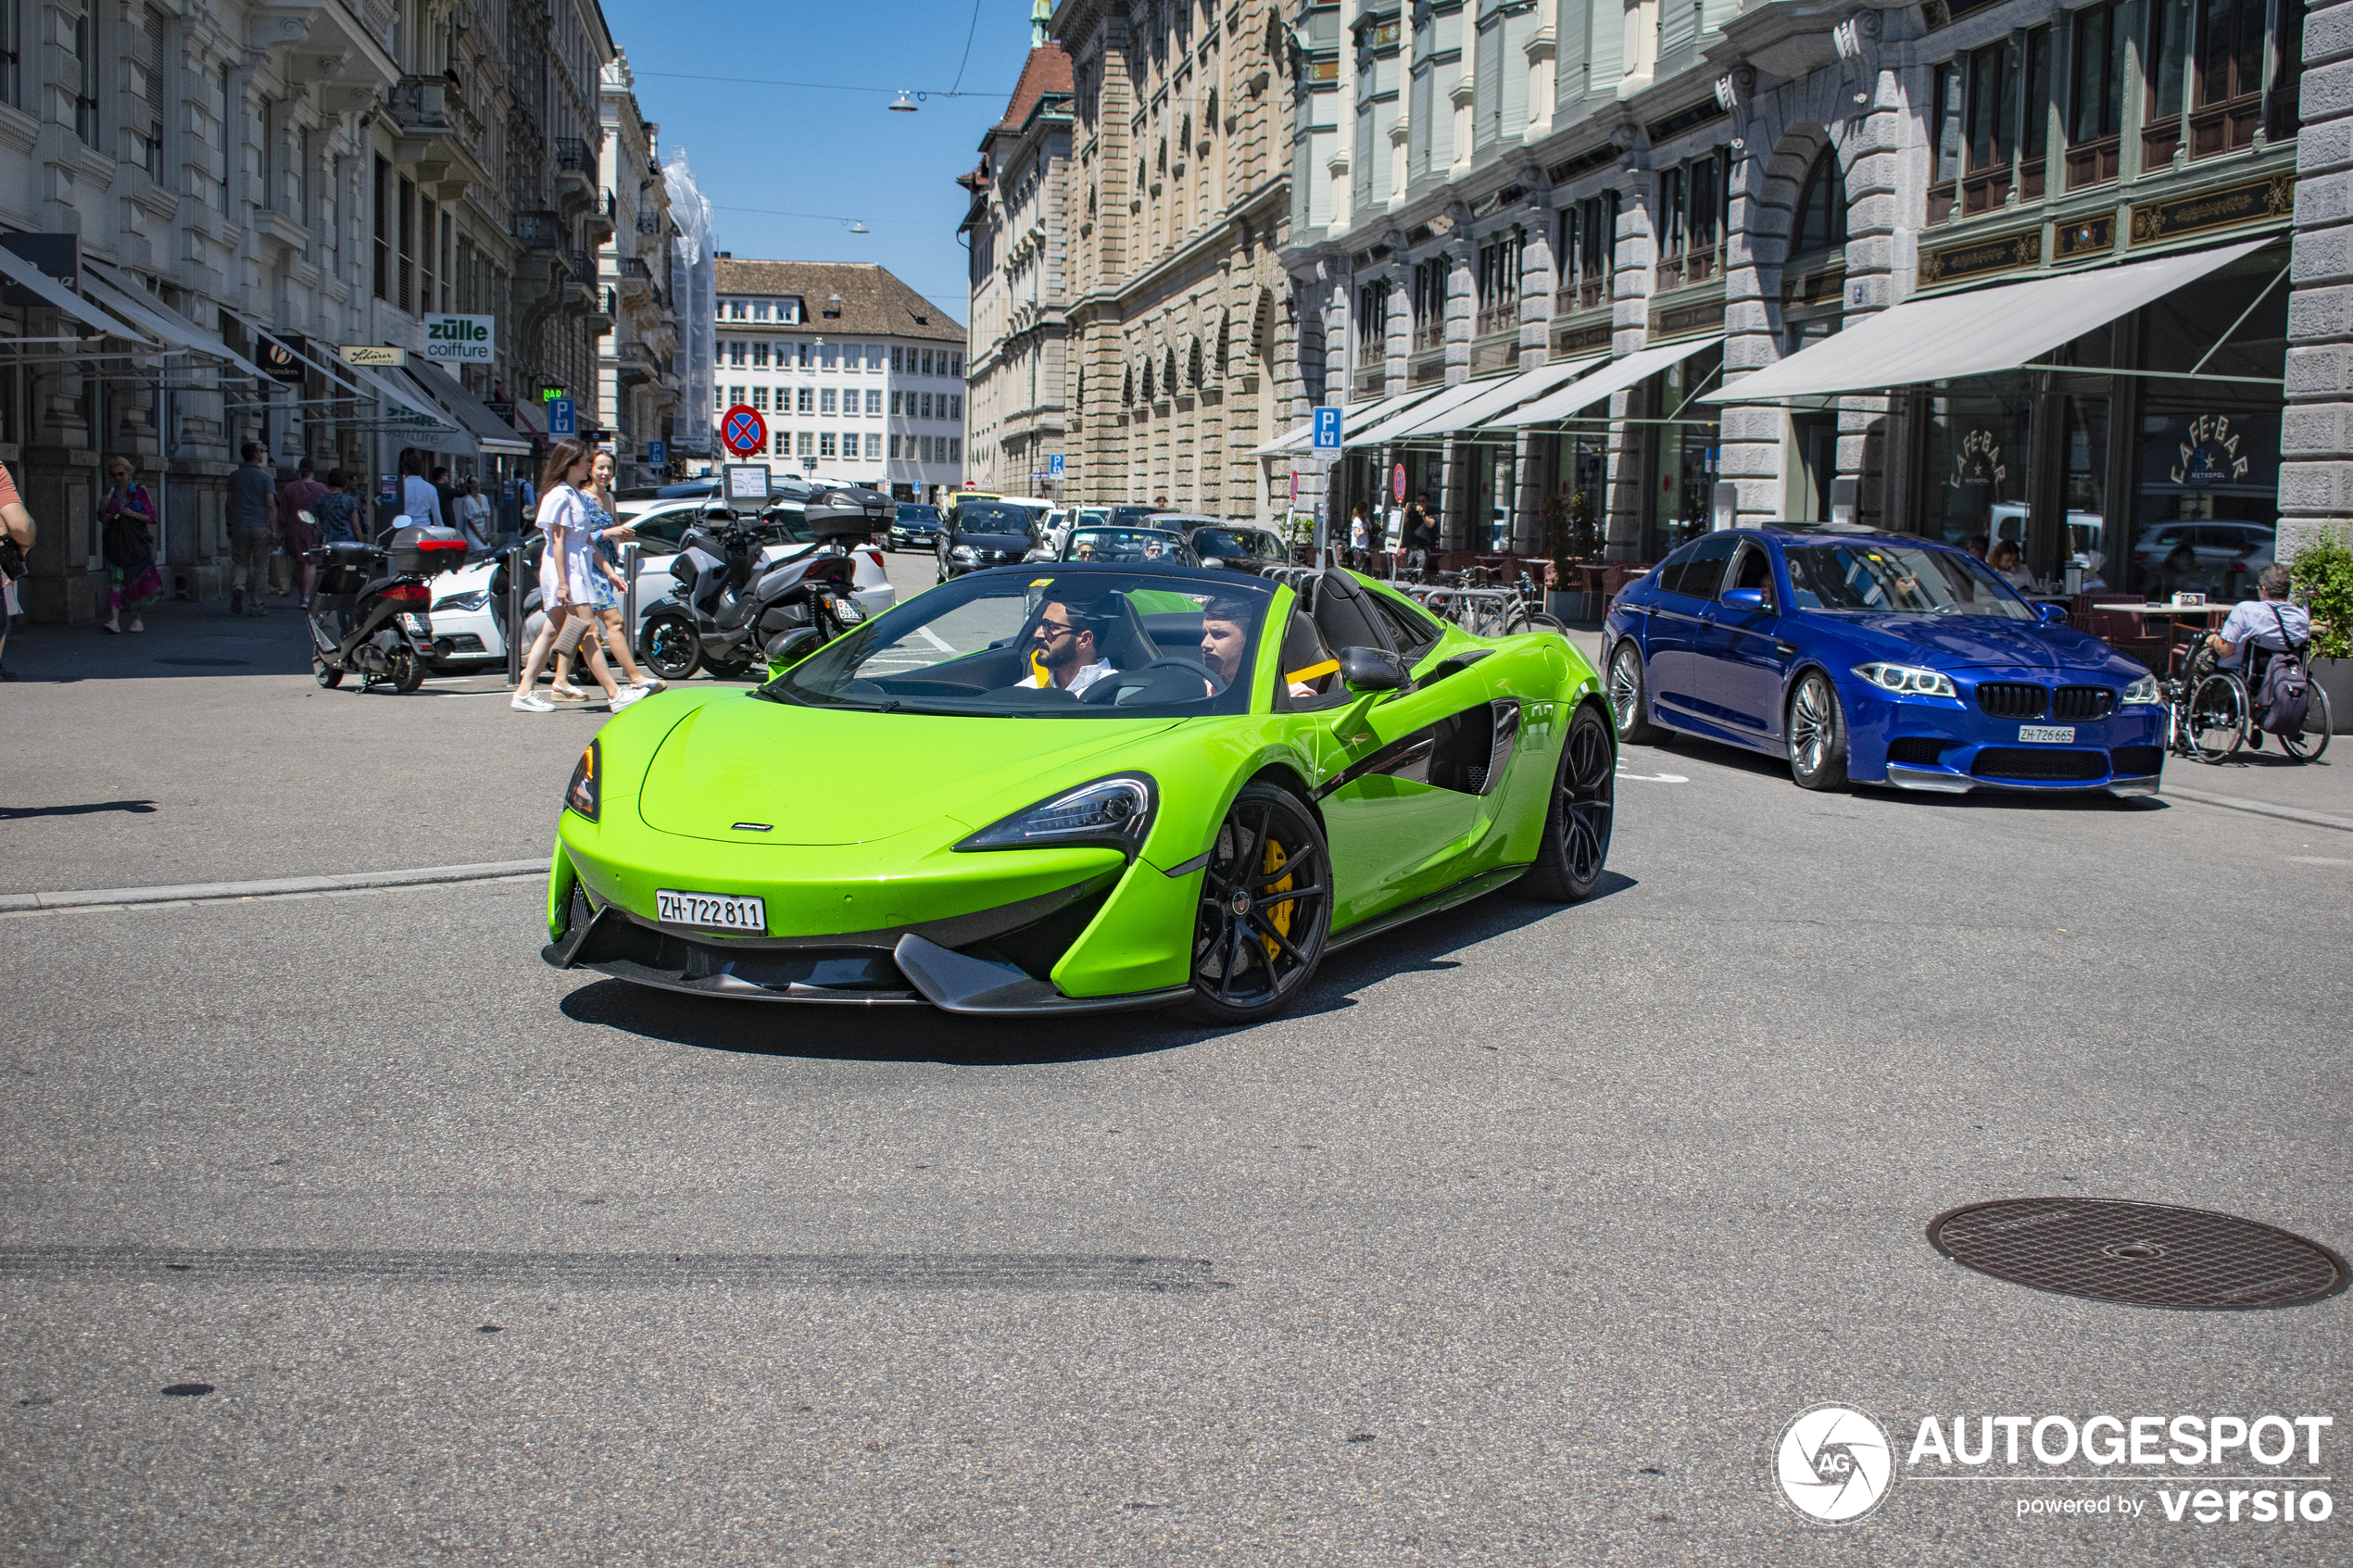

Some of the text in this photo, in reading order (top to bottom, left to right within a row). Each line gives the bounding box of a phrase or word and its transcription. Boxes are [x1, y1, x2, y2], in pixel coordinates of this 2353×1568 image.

[428, 342, 488, 358] coiffure
[543, 389, 562, 402] BAR
[557, 401, 568, 418] P
[1323, 412, 1335, 431] P
